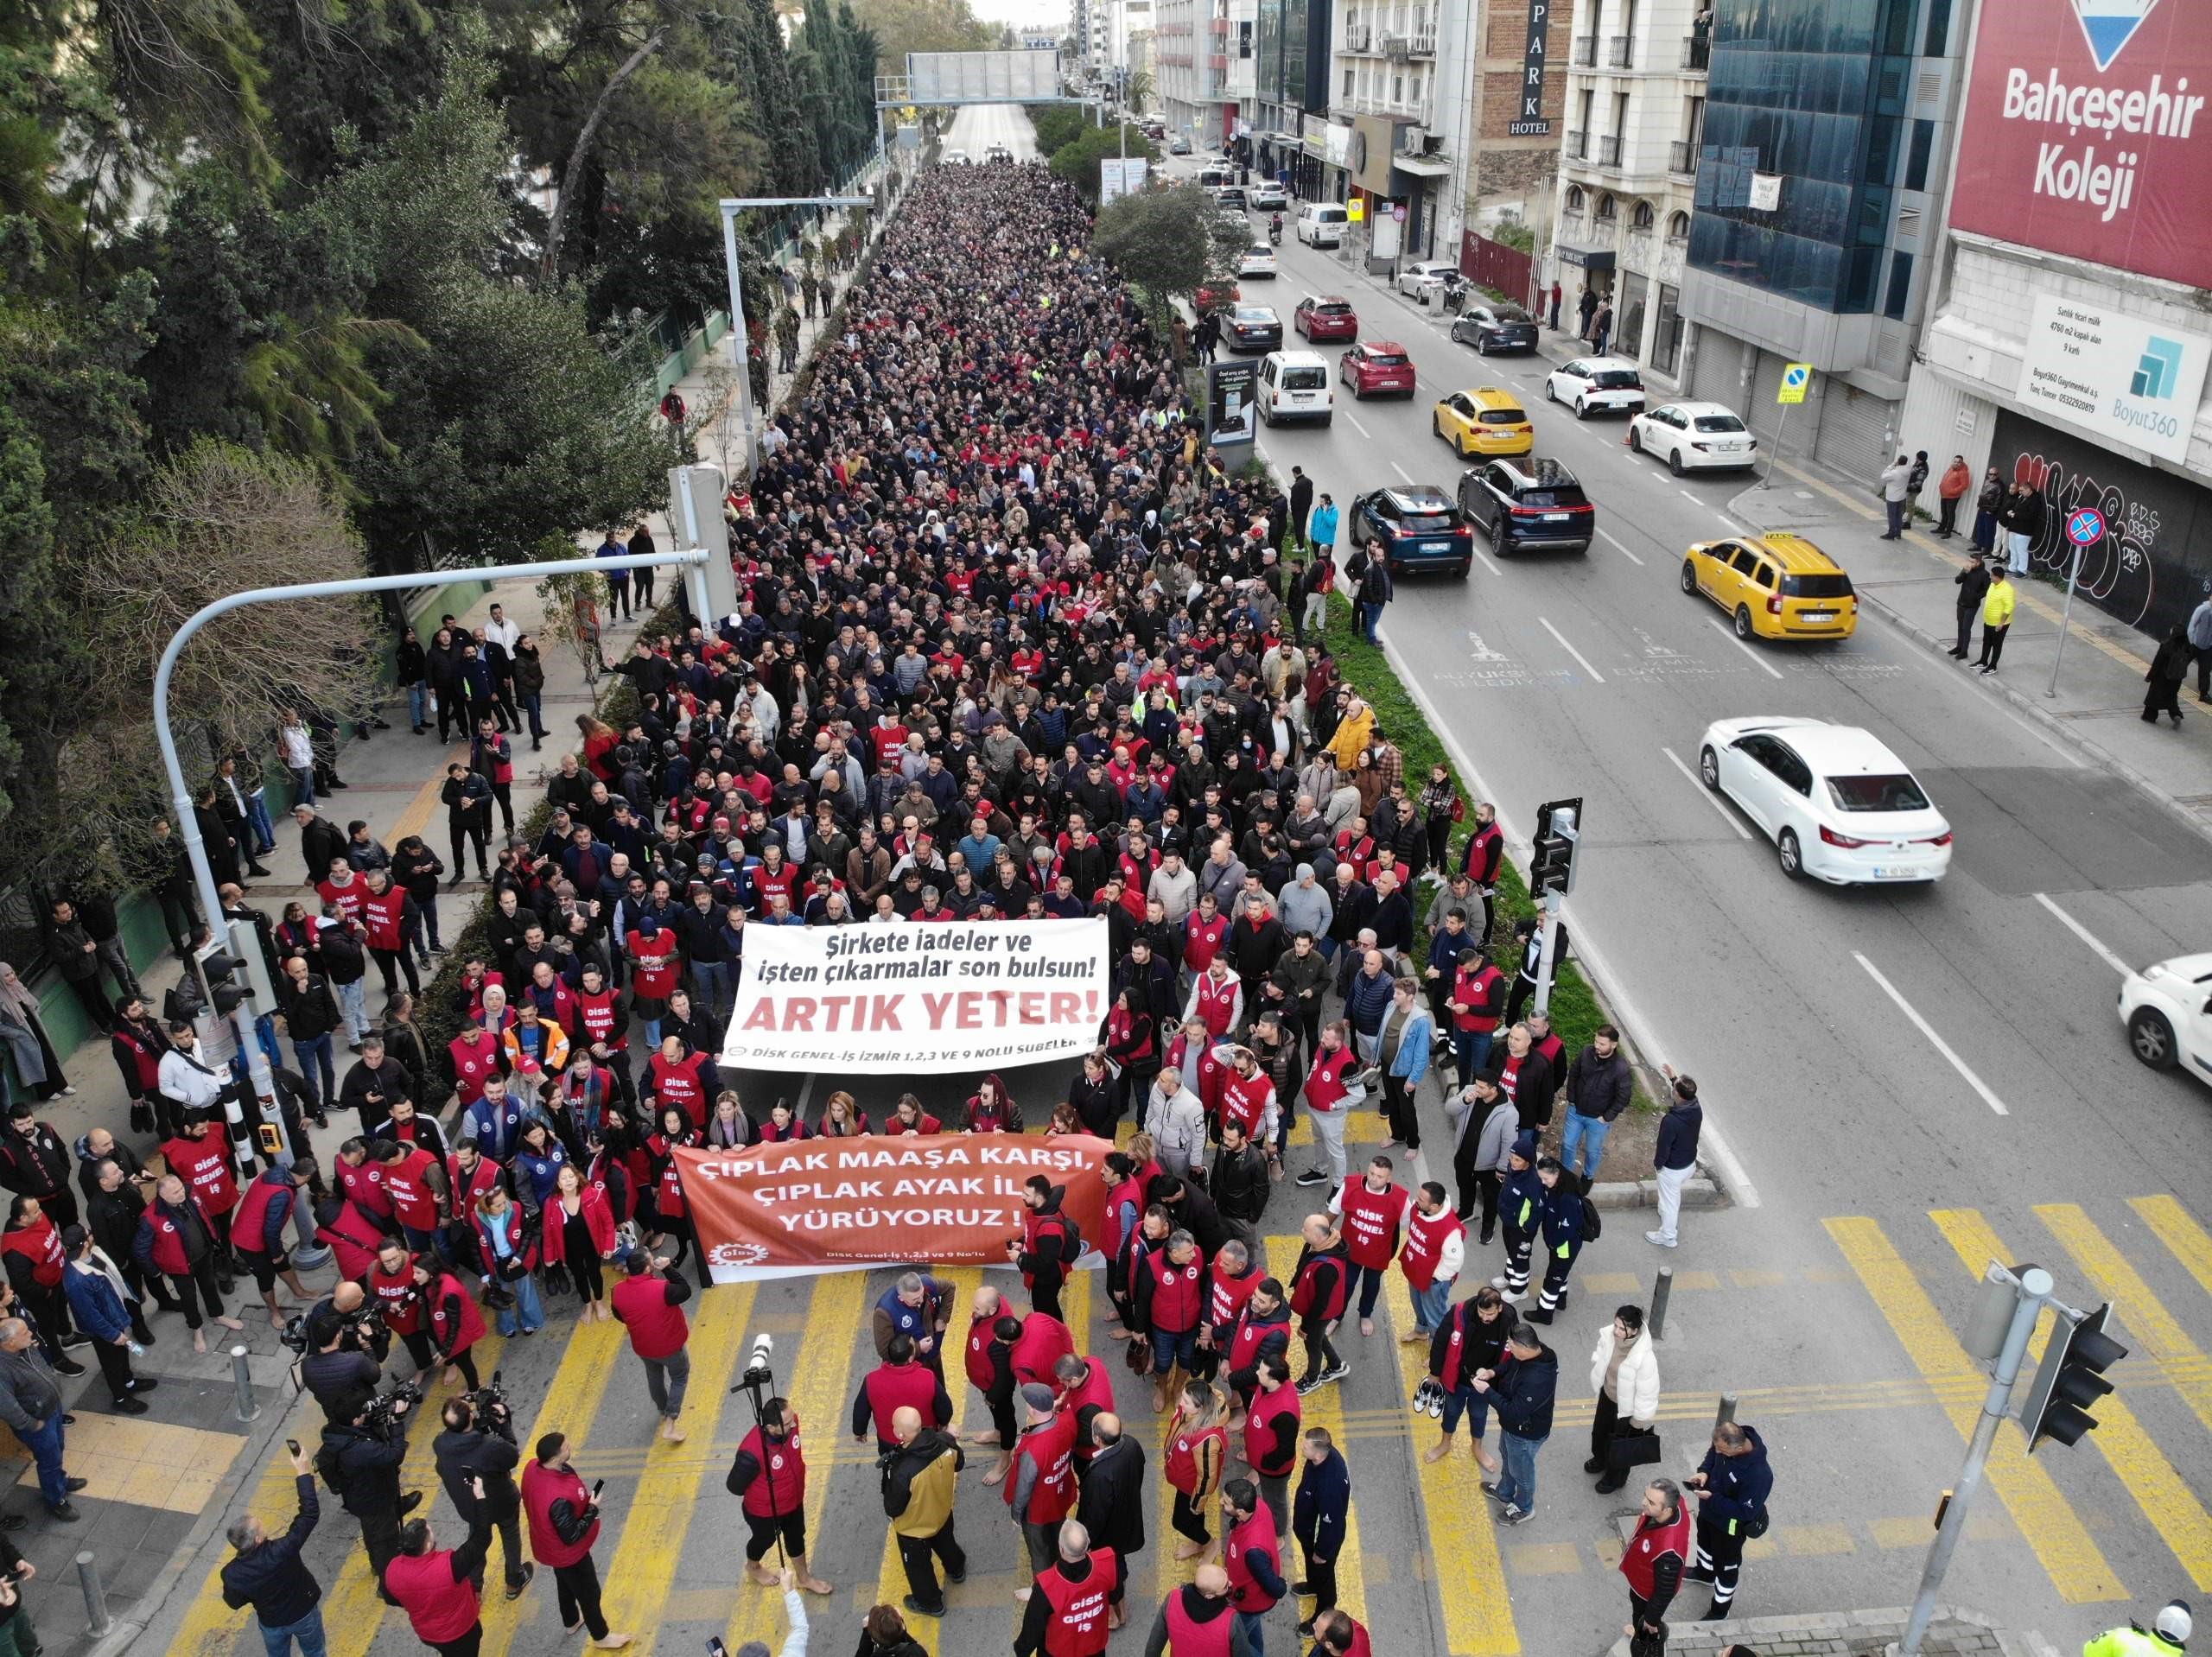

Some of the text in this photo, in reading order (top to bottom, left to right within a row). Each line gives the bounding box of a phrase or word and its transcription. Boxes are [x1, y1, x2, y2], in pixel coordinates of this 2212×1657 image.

[1524, 5, 1545, 115] PARK
[2003, 67, 2204, 141] Bahçeşehir
[1510, 123, 1549, 134] HOTEL
[2034, 143, 2138, 222] Koleji
[2033, 367, 2057, 383] Boyut360
[2113, 398, 2177, 438] Boyut360
[367, 903, 388, 914] DİSK
[824, 928, 1032, 960] Şirkete iadeler ve
[758, 955, 1096, 986] işten çıkarmalar son bulsun!
[588, 1007, 611, 1016] DİSK
[741, 990, 1098, 1032] ARTIK YETER!
[585, 1019, 614, 1027] GENEL
[752, 1048, 787, 1059] DİSK
[790, 1050, 855, 1063] GENEL-İŞ
[859, 1051, 900, 1062] İZMİR
[903, 1051, 936, 1062] 1,2,3
[940, 1051, 959, 1060] VE
[962, 1050, 971, 1060] 9
[975, 1044, 1013, 1058] NOLU
[664, 1077, 690, 1087] DİSK
[194, 1153, 220, 1171] DİSK
[697, 1153, 830, 1180] ÇIPLAK
[839, 1148, 970, 1170] MAAŞA
[981, 1148, 1095, 1170] KARŞI,
[194, 1166, 225, 1185] GENEL
[753, 1174, 1022, 1207] ÇIPLAK AYAK İL
[779, 1209, 1004, 1232] YÜRÜYORUZ
[1356, 1209, 1384, 1222] DİSK
[1351, 1217, 1385, 1235] GENEL
[1410, 1221, 1428, 1244] DİSK
[378, 1286, 406, 1297] DİSK
[1214, 1281, 1233, 1305] DİSK
[1071, 1592, 1103, 1611] DİSK
[1063, 1603, 1104, 1624] GENEL
[1077, 1622, 1092, 1633] İŞ
